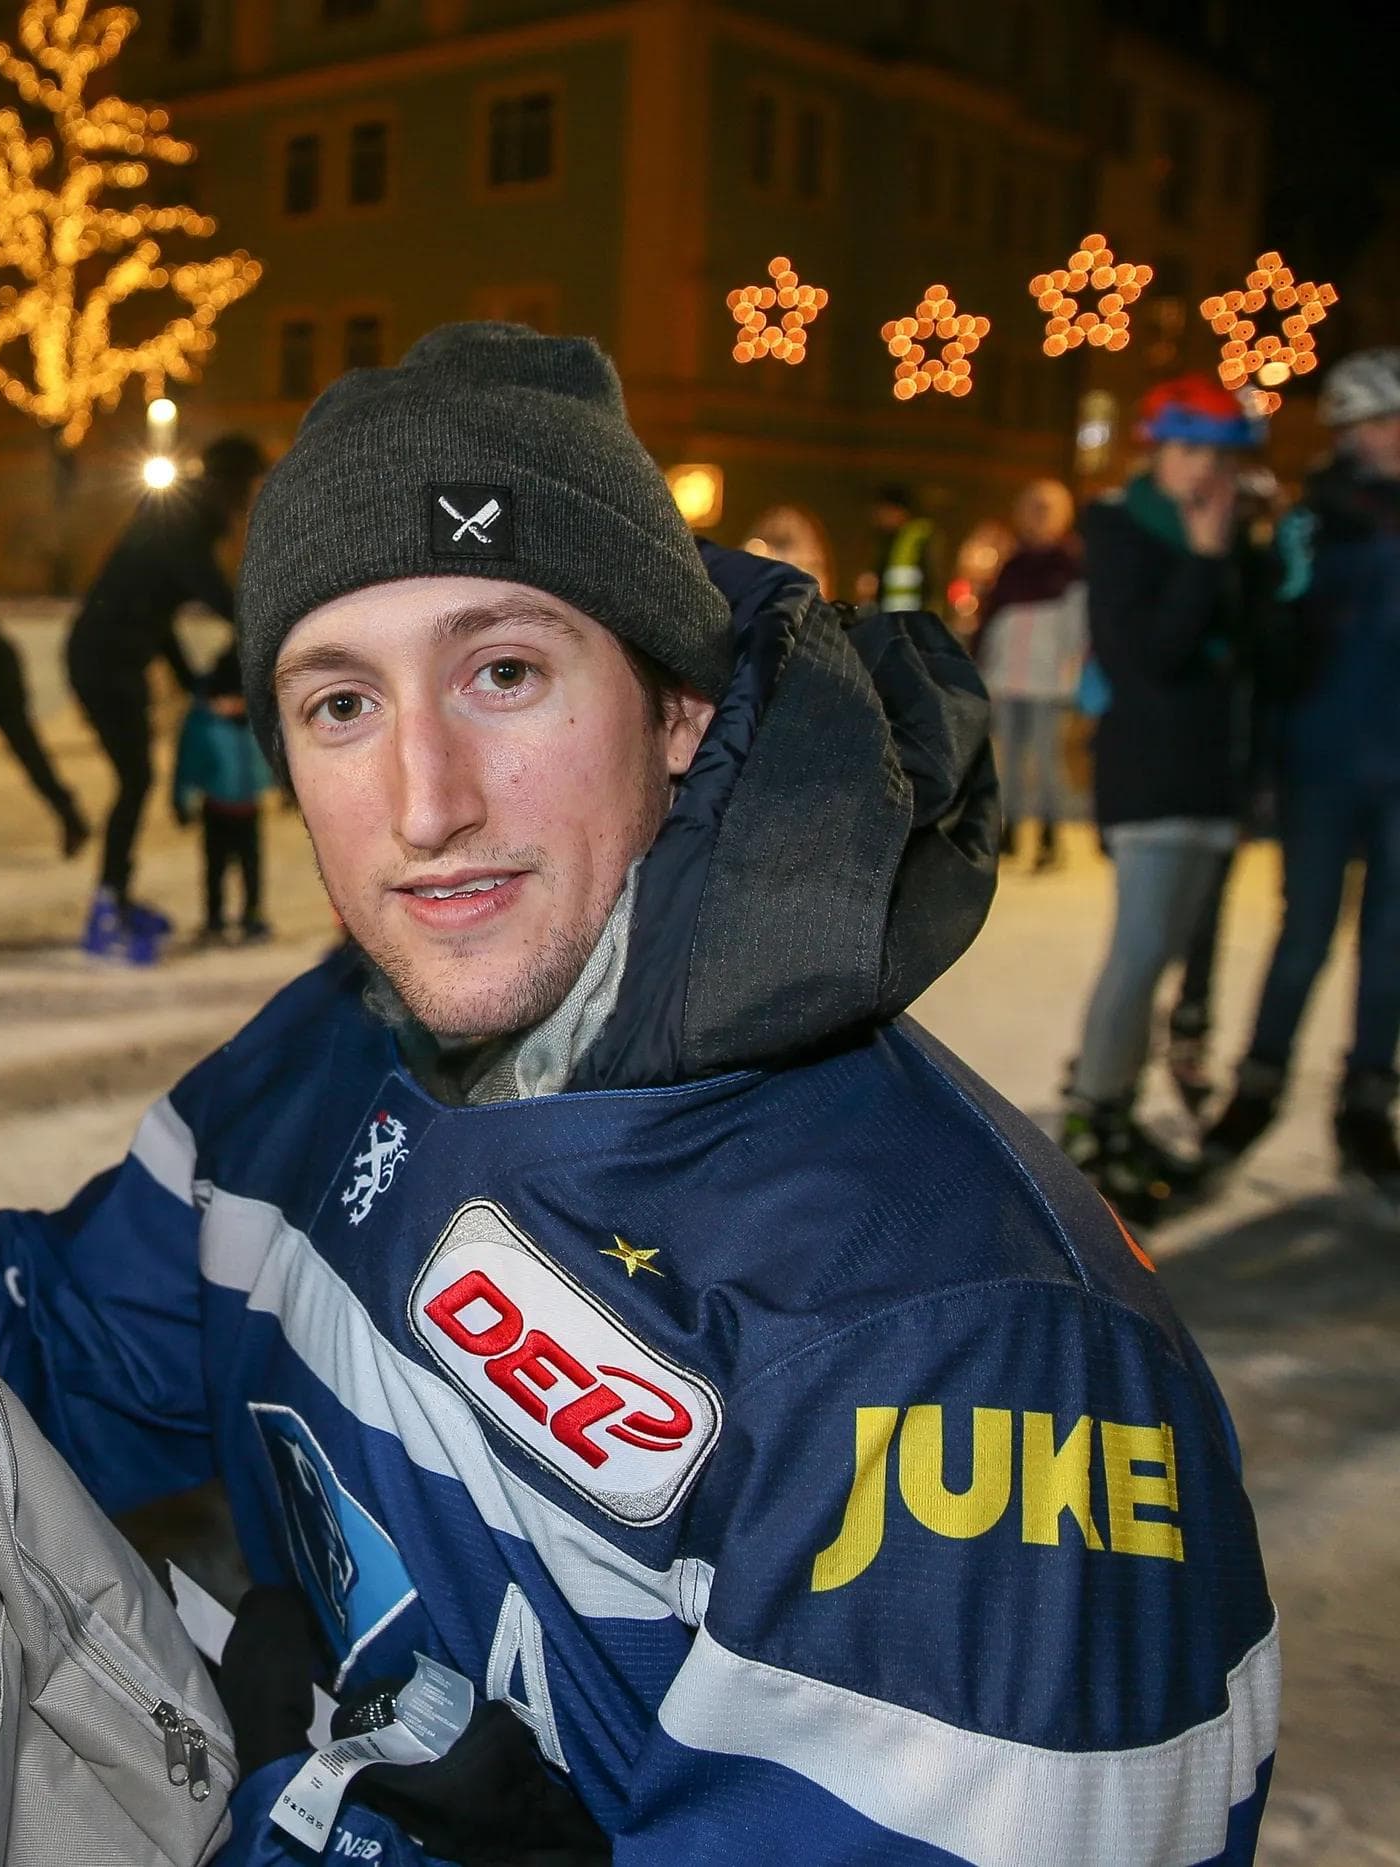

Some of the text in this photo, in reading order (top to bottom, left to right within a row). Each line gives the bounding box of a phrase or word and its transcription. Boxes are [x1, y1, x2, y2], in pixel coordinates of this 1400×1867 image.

[423, 1270, 627, 1470] DEL
[811, 1404, 1185, 1592] JUKE
[486, 1582, 571, 1774] A
